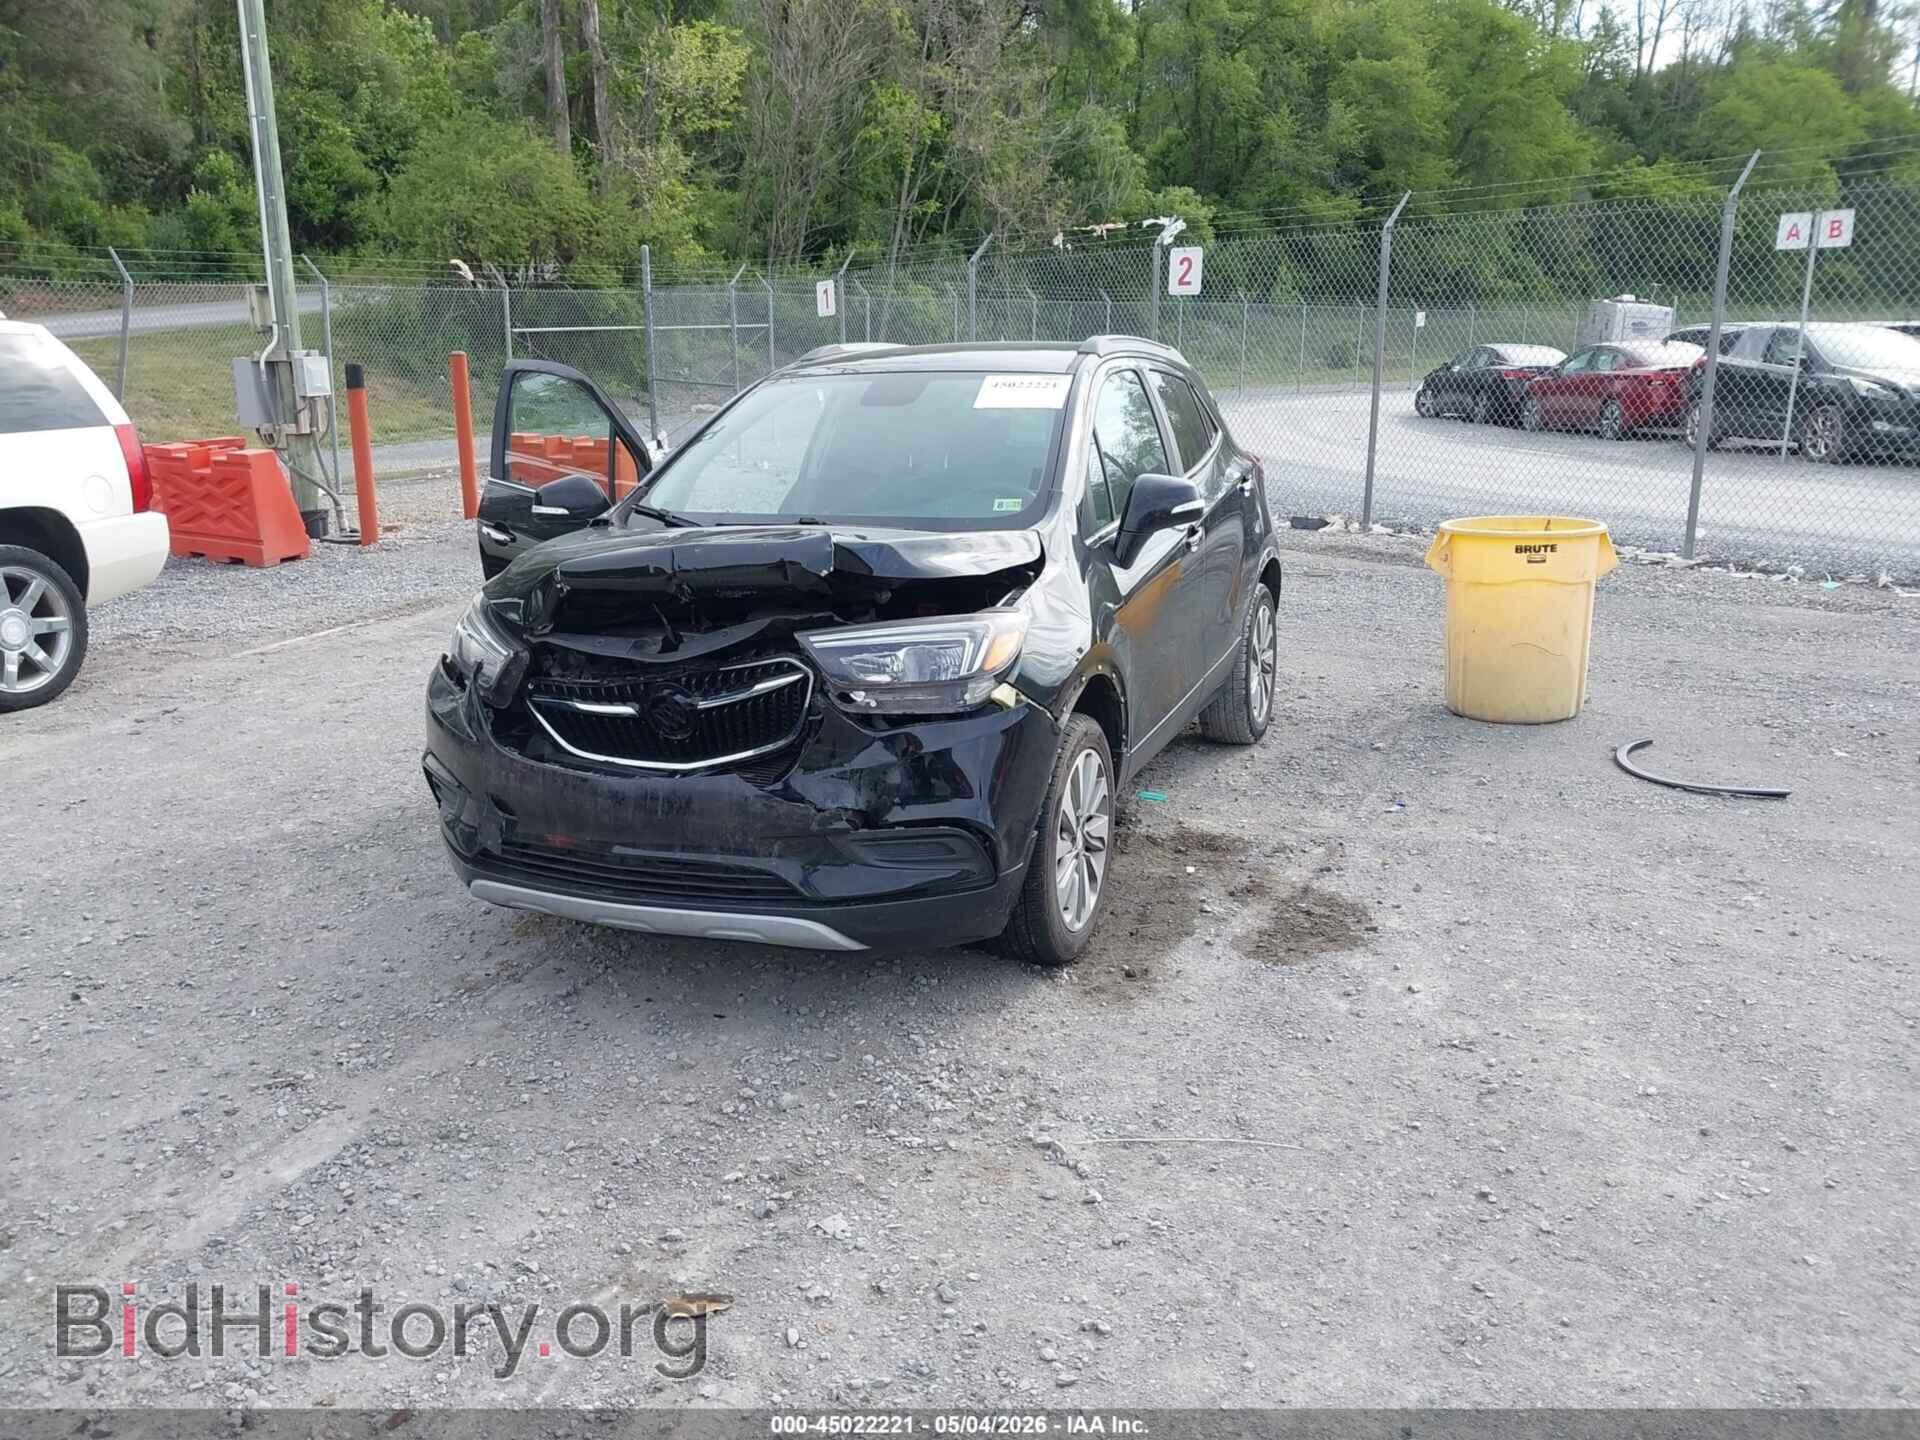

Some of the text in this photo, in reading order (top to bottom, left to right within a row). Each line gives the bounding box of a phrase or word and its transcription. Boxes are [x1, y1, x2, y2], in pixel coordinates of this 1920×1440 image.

[1786, 223, 1800, 241] A
[1829, 220, 1843, 239] B
[1178, 256, 1193, 286] 2
[823, 288, 829, 309] 1
[1515, 544, 1558, 554] BRUTE
